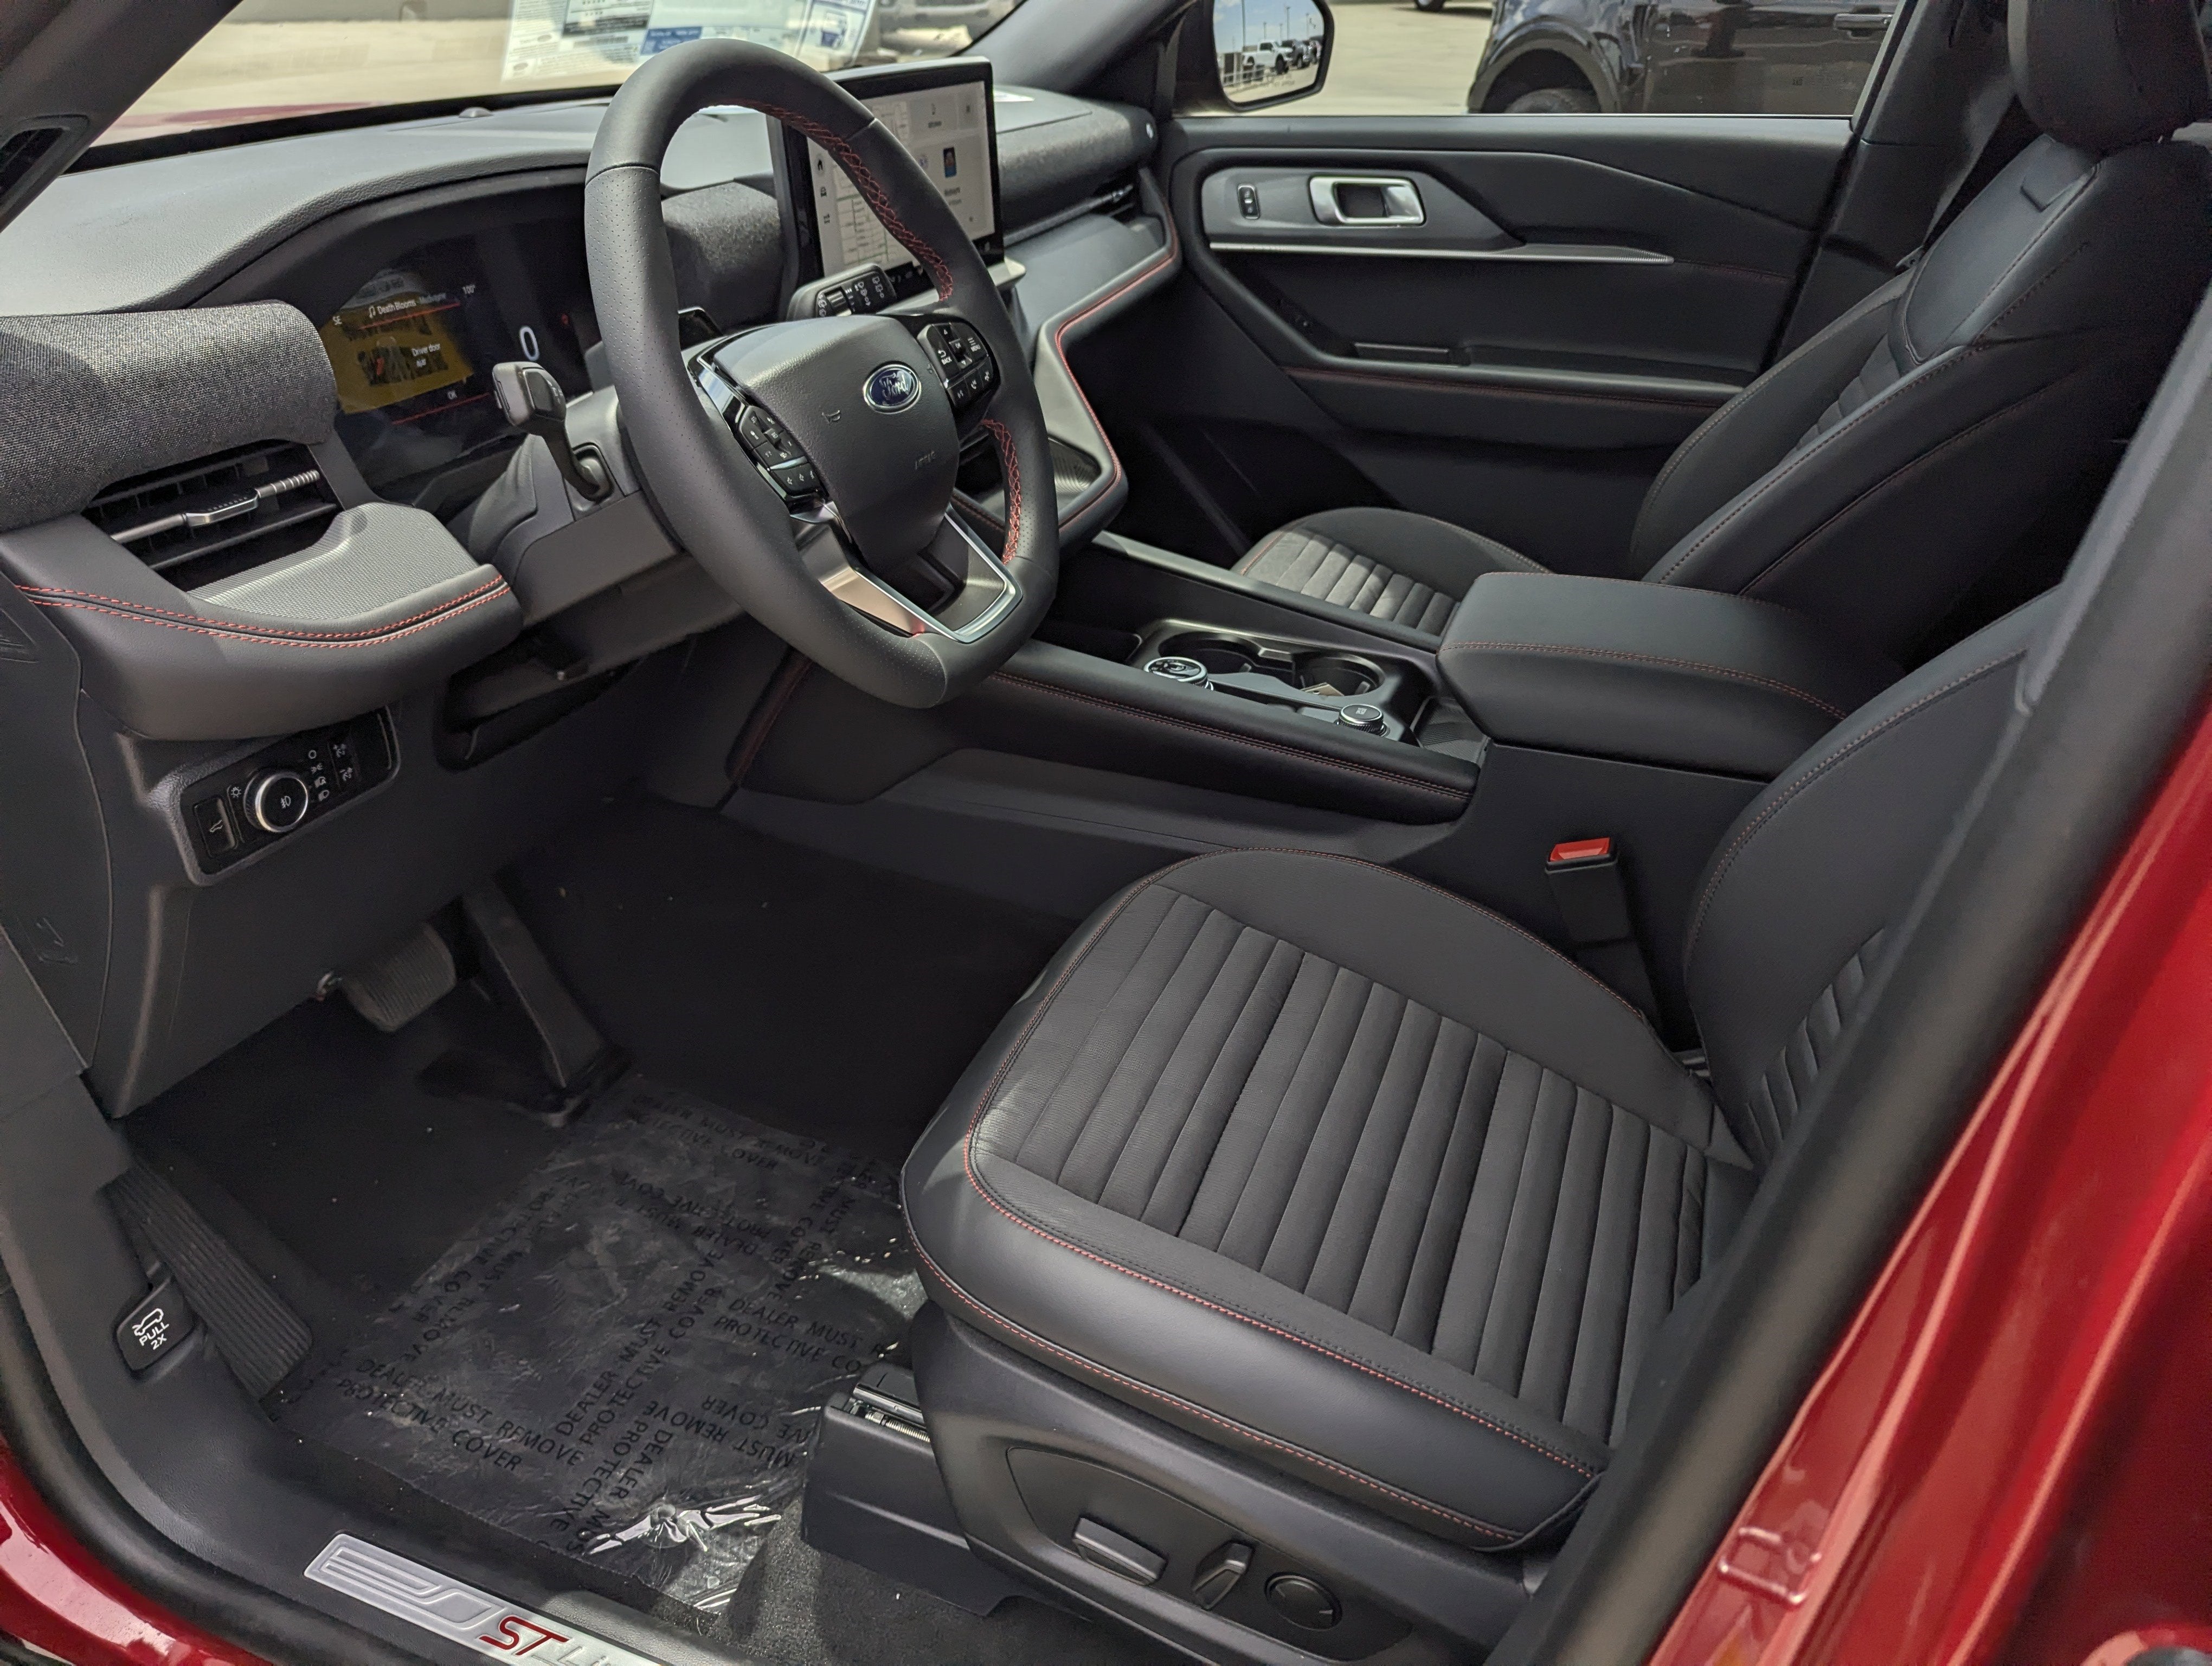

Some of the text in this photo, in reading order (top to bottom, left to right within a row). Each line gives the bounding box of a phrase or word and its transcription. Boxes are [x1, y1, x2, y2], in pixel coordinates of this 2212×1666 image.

[332, 316, 342, 325] SE
[377, 303, 395, 315] Death
[394, 299, 417, 311] Blooms
[519, 326, 539, 361] 0
[879, 372, 909, 400] Ford
[139, 1322, 170, 1346] PULL
[151, 1334, 167, 1350] 2X
[554, 1370, 619, 1437] DEALER
[661, 1250, 725, 1312] REMOVE
[713, 1316, 826, 1363] PROTECTIVE
[728, 1298, 864, 1349] DEALER MUST
[578, 1286, 724, 1446] PROTECTIVE COVER
[432, 1387, 493, 1424] MUST
[497, 1420, 584, 1466] REMOVE
[644, 1400, 730, 1445] REMOVE
[700, 1394, 771, 1430] COVER
[452, 1429, 523, 1471] COVER
[732, 1437, 797, 1469] MUST
[549, 1419, 650, 1533] PROTECTIVE
[567, 1428, 674, 1555] DEALER MUS
